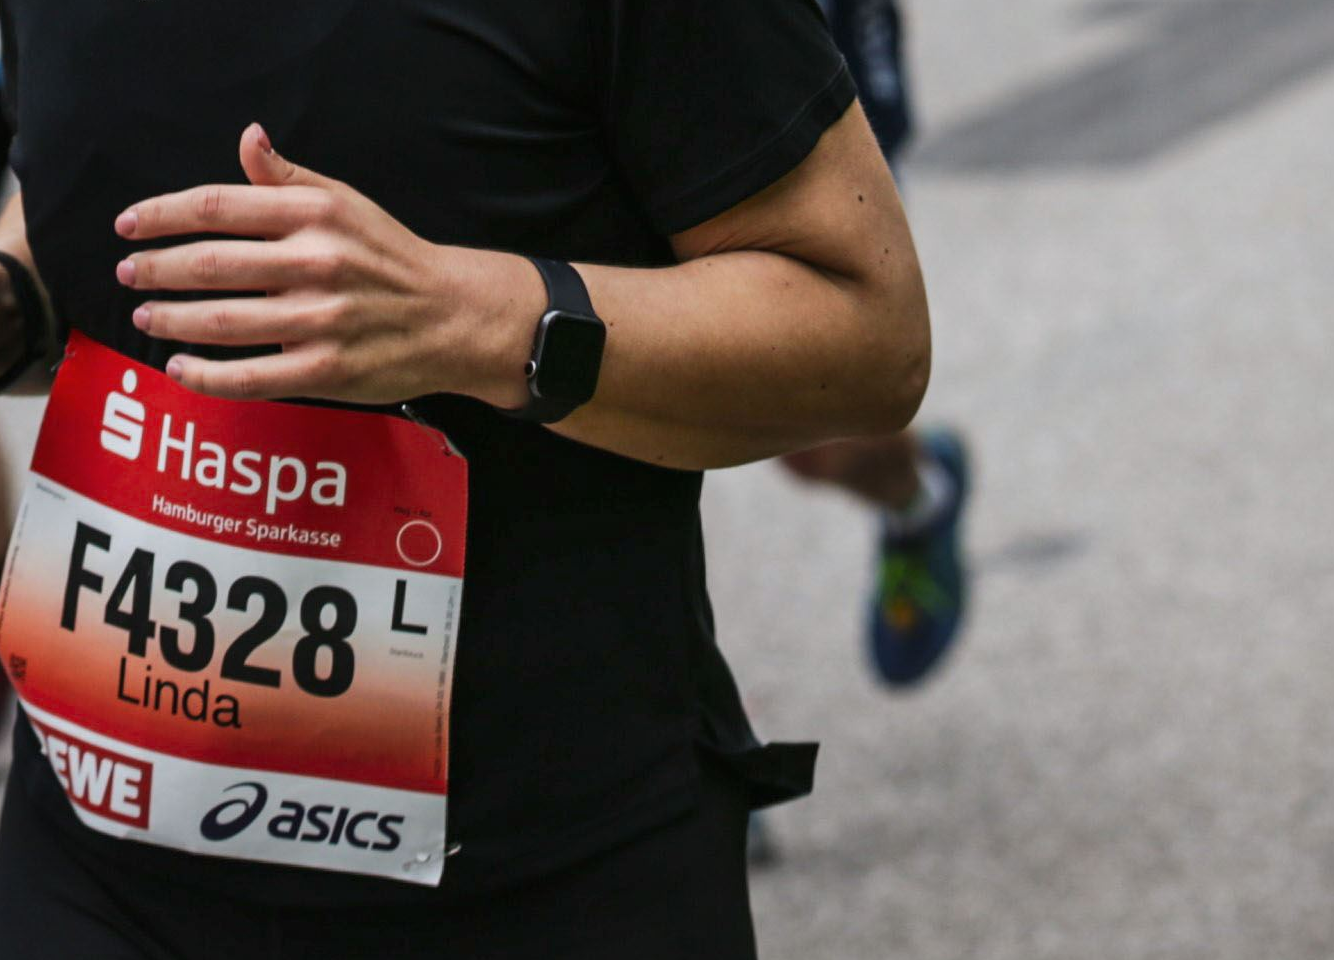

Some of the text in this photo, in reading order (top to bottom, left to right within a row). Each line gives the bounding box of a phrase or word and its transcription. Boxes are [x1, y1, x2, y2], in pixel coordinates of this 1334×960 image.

[156, 414, 348, 515] Haspa
[151, 493, 342, 548] Hamburger Sparkasse
[59, 521, 358, 698] F4328
[391, 579, 429, 636] L
[116, 657, 242, 729] Linda
